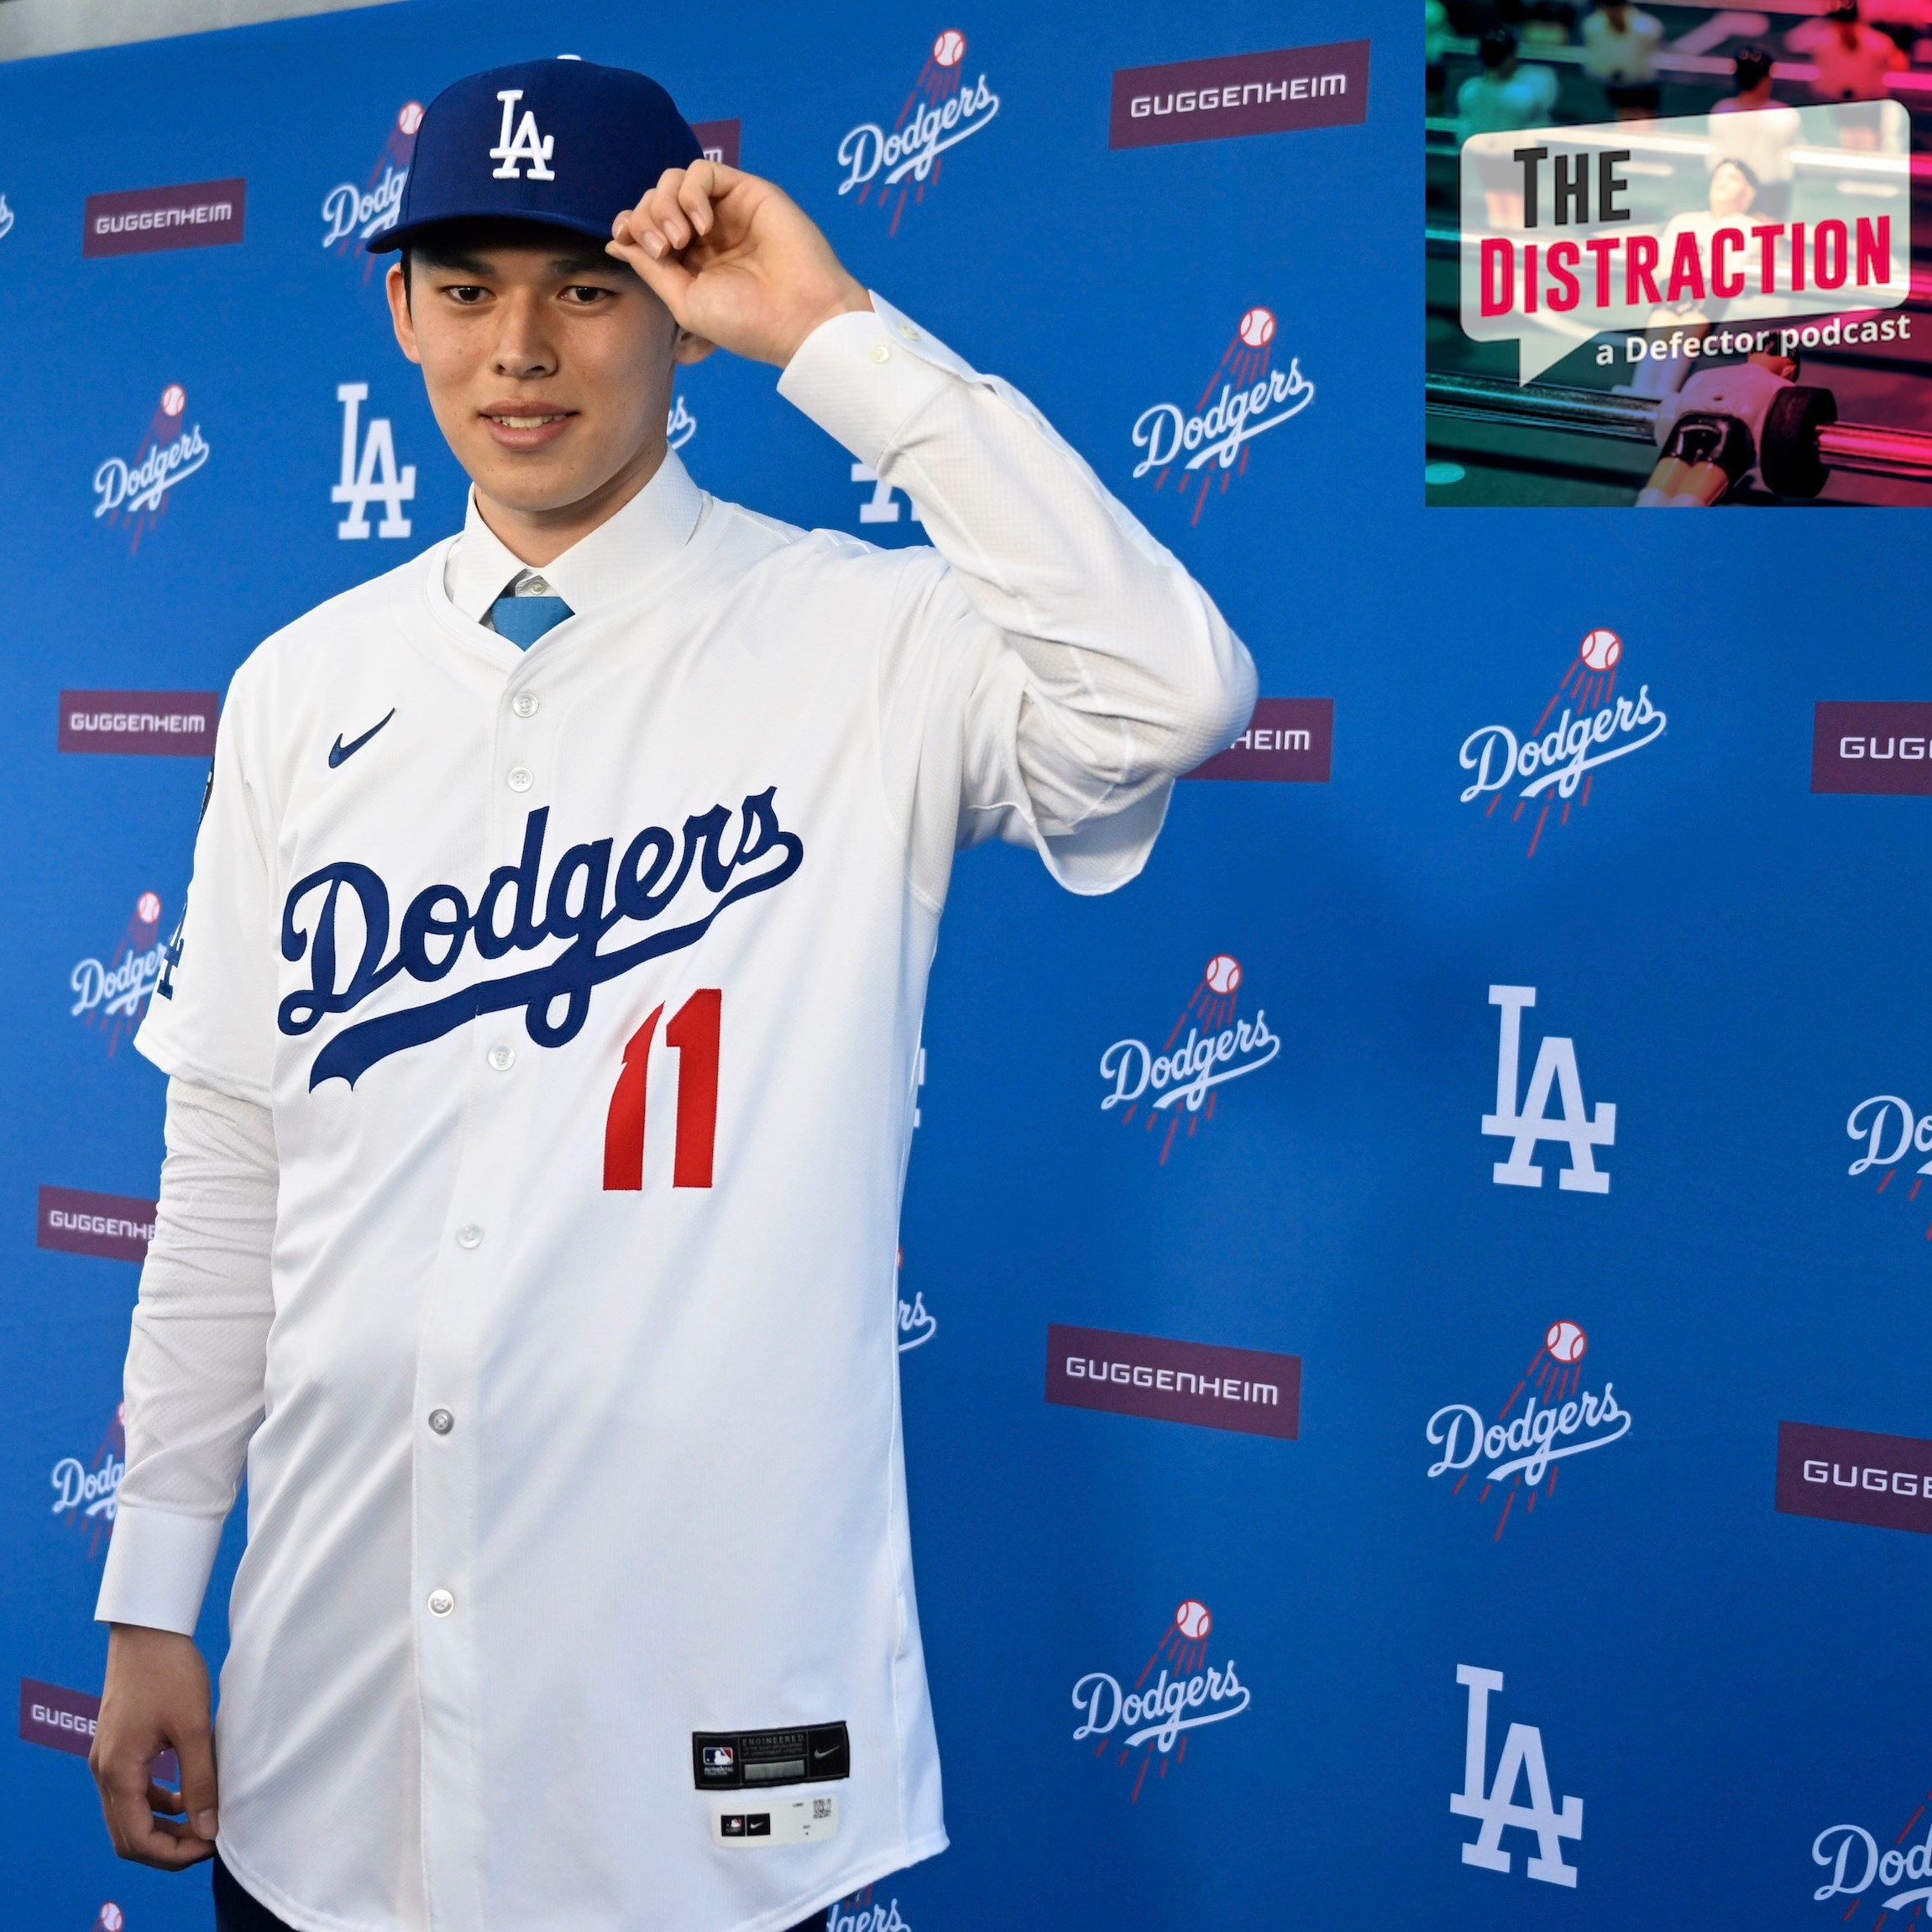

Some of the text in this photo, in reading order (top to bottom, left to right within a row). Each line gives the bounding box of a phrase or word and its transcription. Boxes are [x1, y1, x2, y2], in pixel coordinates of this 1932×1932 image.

[490, 89, 555, 181] LA
[837, 74, 999, 195] Dodgers
[1131, 72, 1347, 118] GUGGENHEIM
[96, 203, 232, 235] GUGGENHEIM
[332, 383, 416, 539] LA
[1132, 358, 1316, 479] Dodgers
[94, 424, 209, 518] Dodgers
[71, 712, 205, 733] GUGGENHEIM
[1459, 684, 1667, 803] Dodgers
[278, 787, 804, 1094] Dodgers
[603, 988, 722, 1191] 11
[1100, 1009, 1280, 1111] Dodgers
[1481, 984, 1616, 1194] LA
[1065, 1356, 1279, 1406] GUGGENHEIM
[1426, 1382, 1631, 1486] Dodgers
[742, 1734, 804, 1746] ENGINEERED
[1071, 1659, 1250, 1753] Dodgers
[1449, 1663, 1584, 1888] LA
